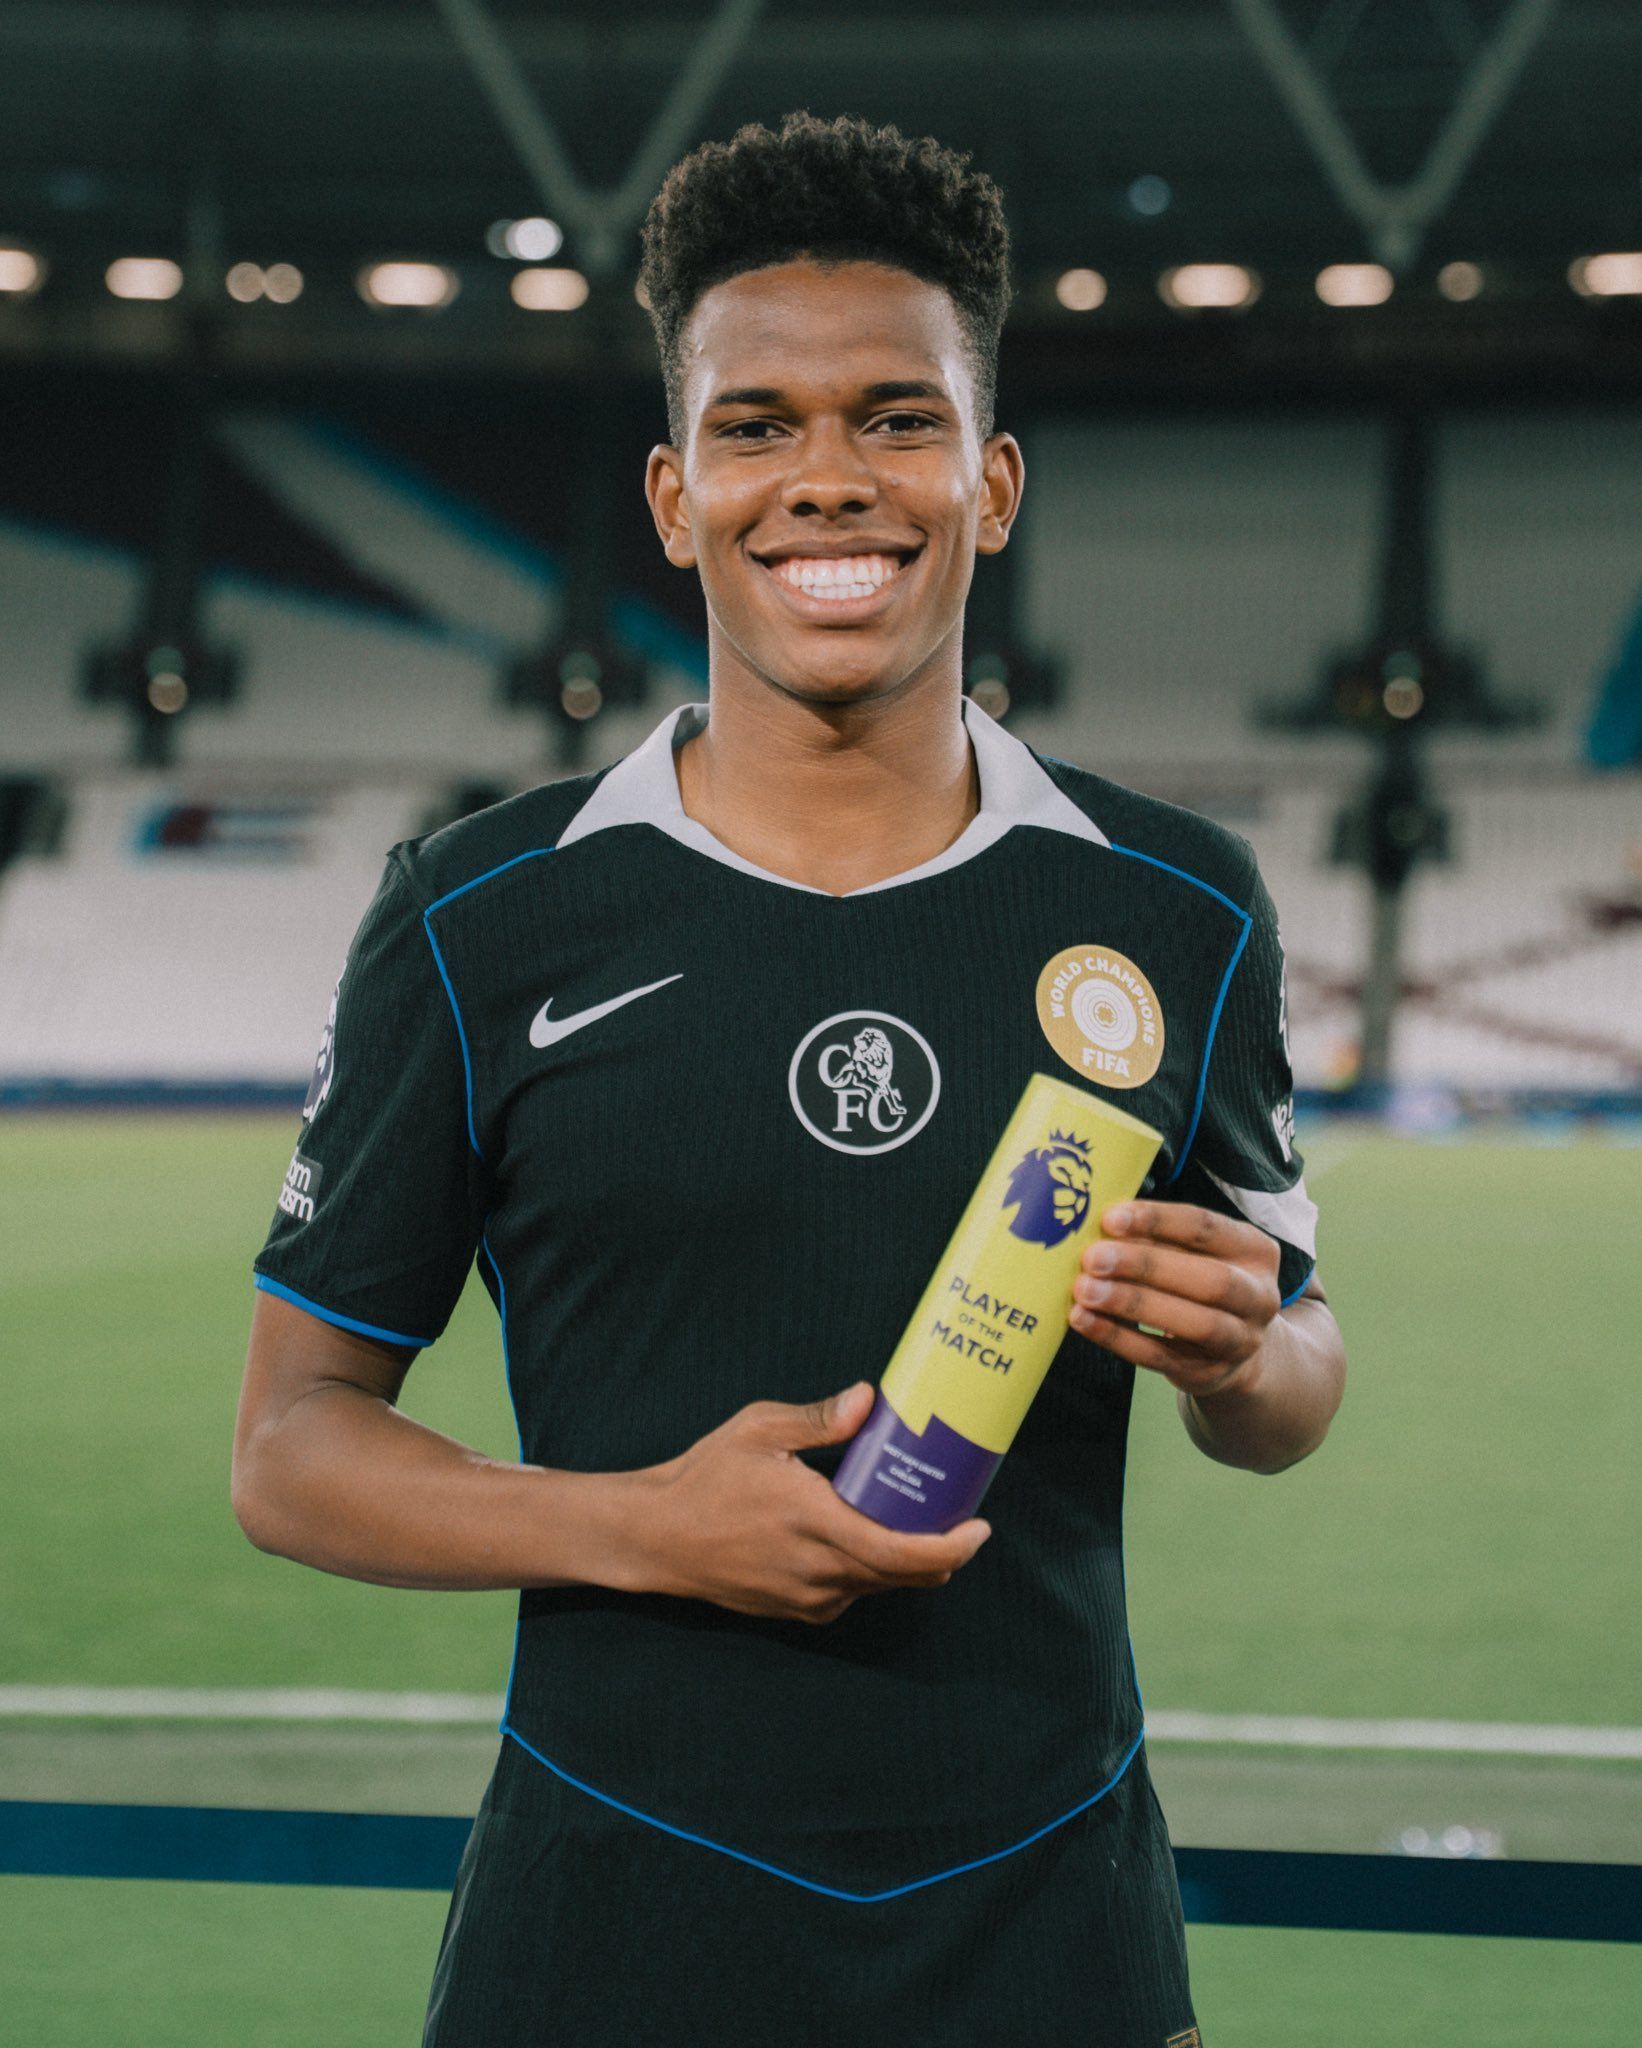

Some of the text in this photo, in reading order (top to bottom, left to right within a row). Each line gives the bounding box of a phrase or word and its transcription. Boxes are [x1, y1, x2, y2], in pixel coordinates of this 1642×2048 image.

[1050, 957, 1156, 1046] WORLD CHAMPIONS
[1081, 1047, 1130, 1078] FIFA
[949, 1276, 1038, 1334] PLAYER
[958, 1312, 1005, 1342] OF THE
[930, 1320, 1014, 1375] MATCH
